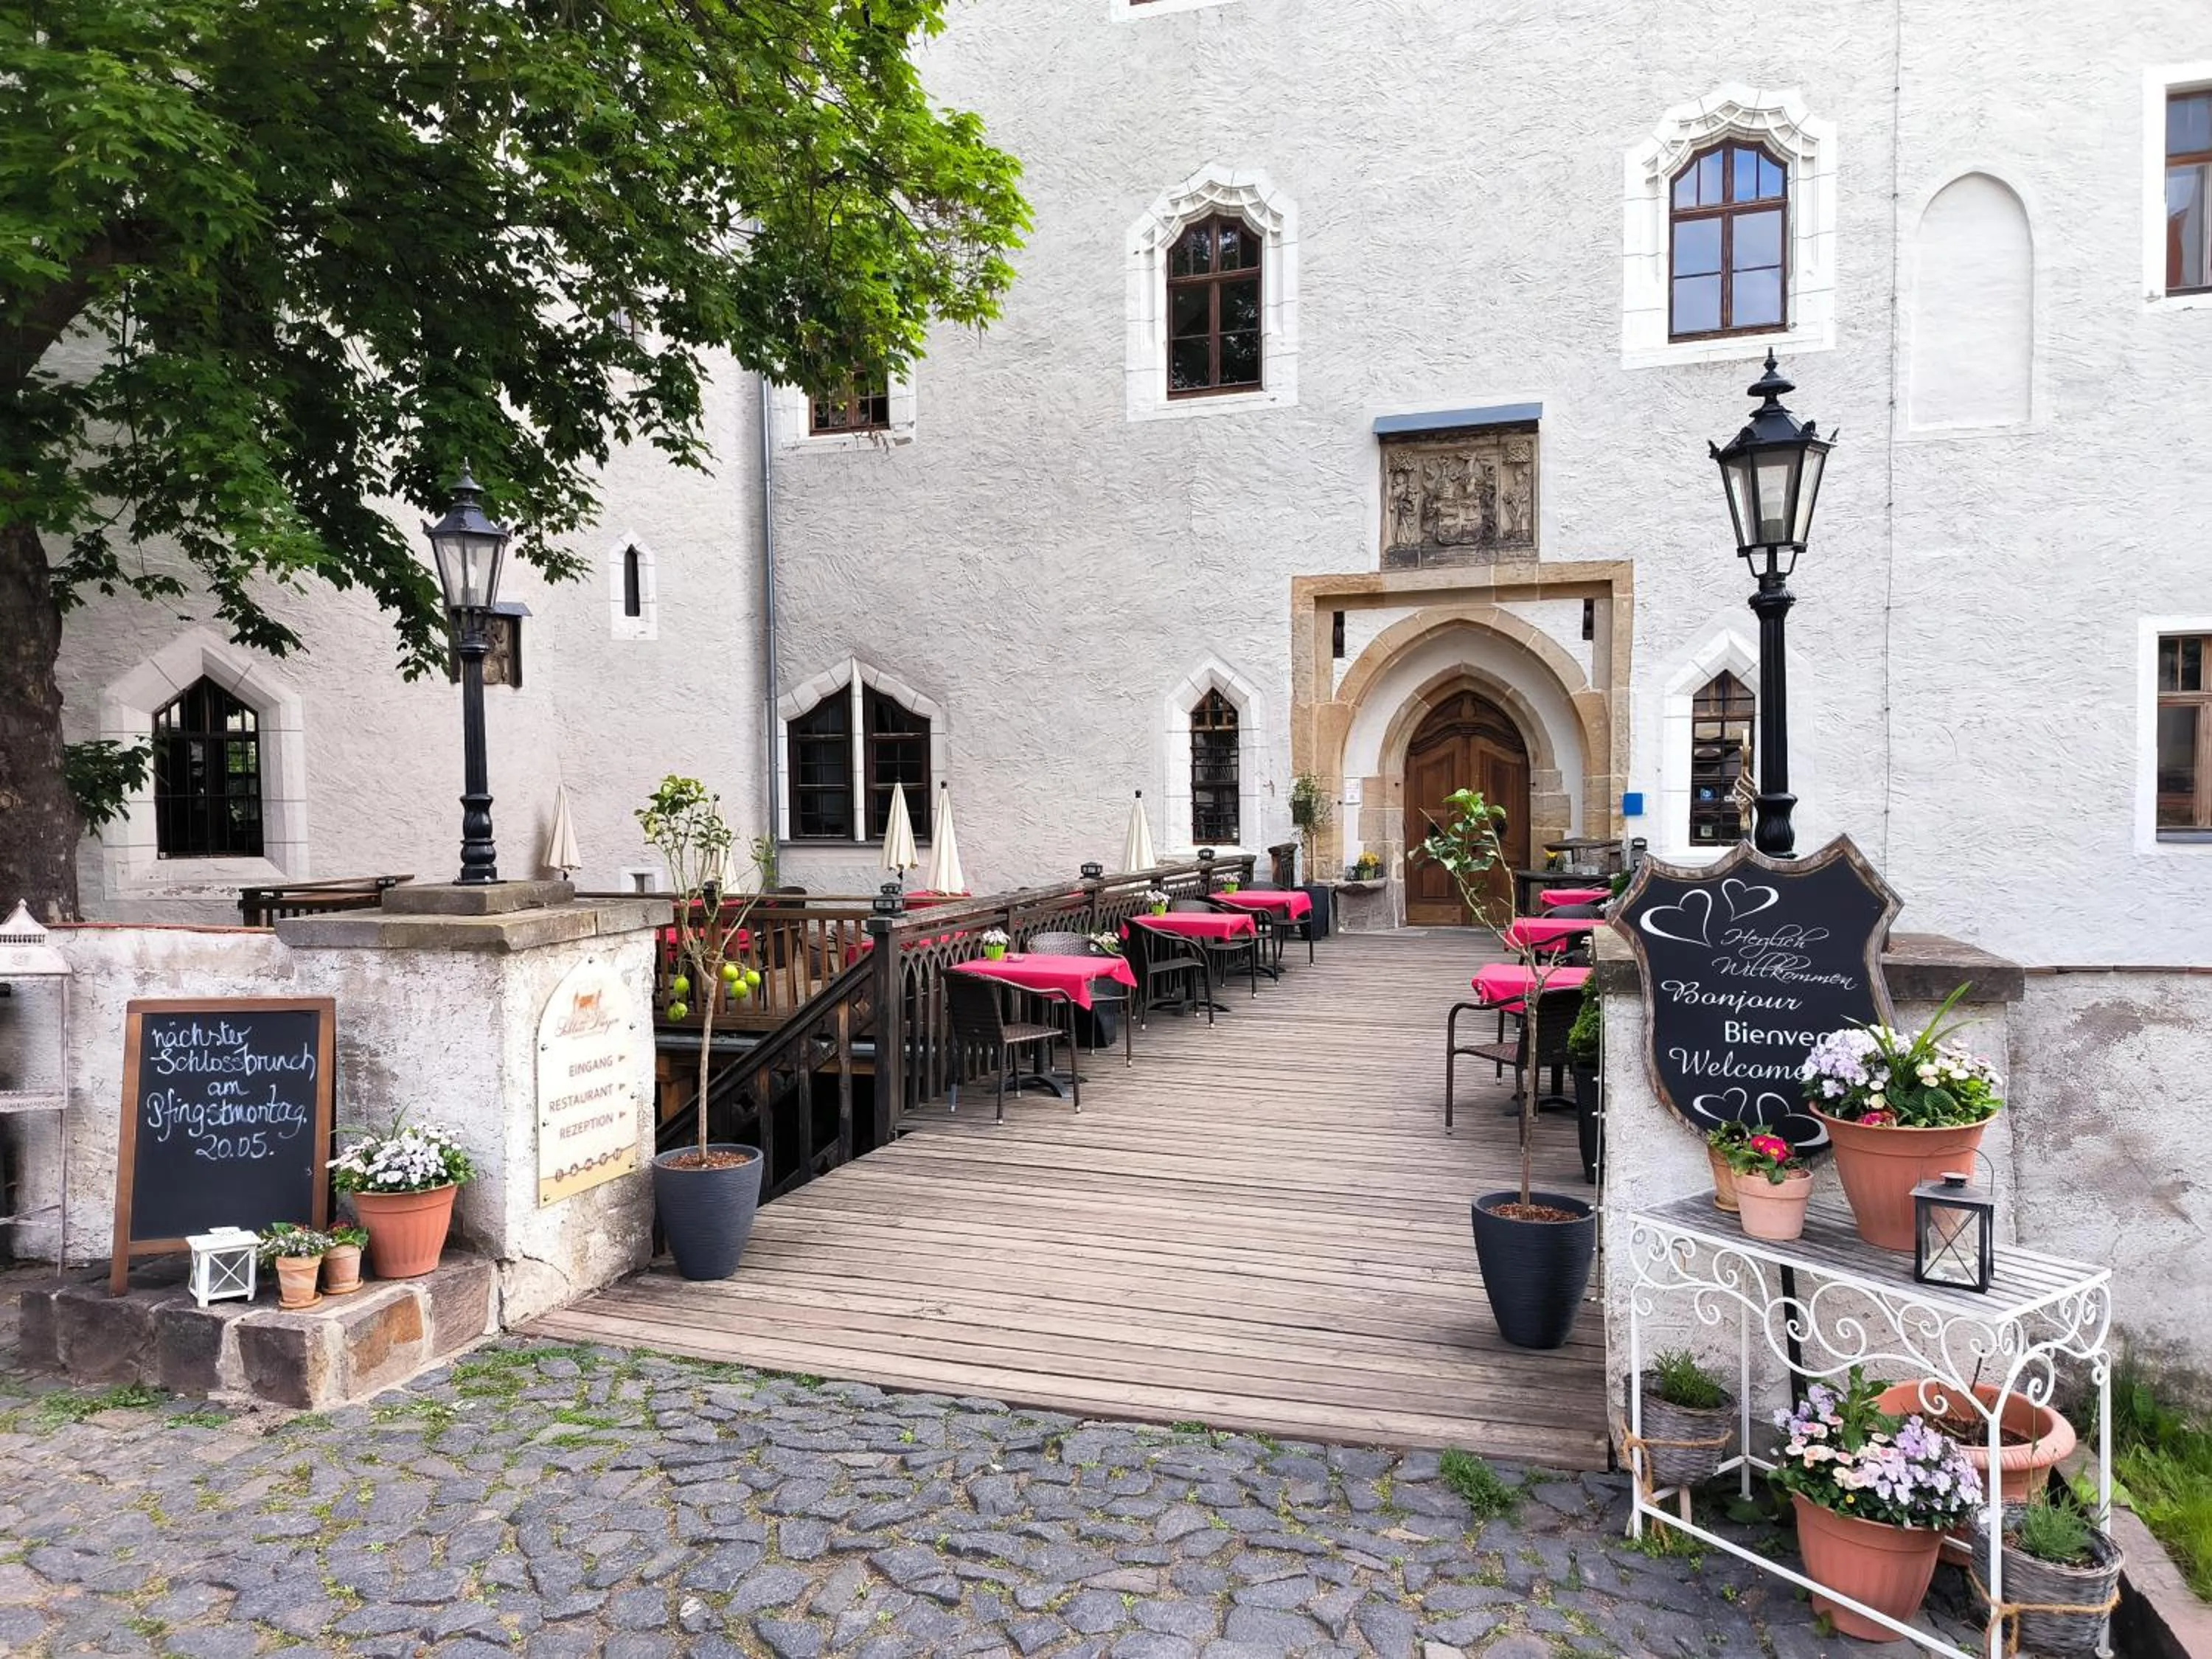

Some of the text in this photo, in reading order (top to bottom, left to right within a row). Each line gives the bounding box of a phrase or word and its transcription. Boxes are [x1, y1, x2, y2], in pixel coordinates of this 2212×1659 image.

[1720, 924, 1829, 959] Herzlich
[1711, 952, 1858, 990] Willkommen
[1661, 980, 1803, 1014] Bonjour
[151, 1021, 252, 1048] nächster
[150, 1042, 316, 1081] Schlossbrunch
[568, 1054, 613, 1077] EINGANG
[207, 1080, 251, 1096] am
[549, 1083, 614, 1113] RESTAURANT
[560, 1112, 614, 1140] REZEPTION
[195, 1131, 275, 1161] 20.05.
